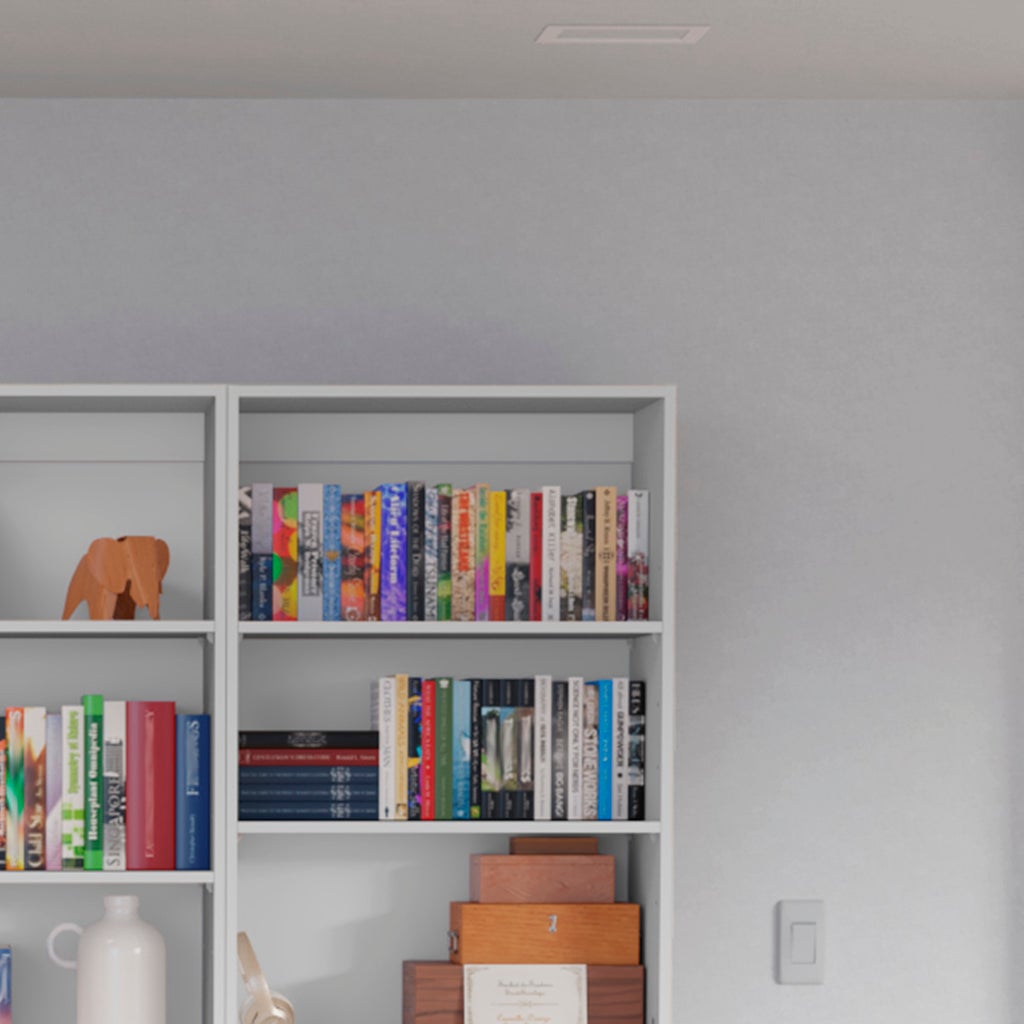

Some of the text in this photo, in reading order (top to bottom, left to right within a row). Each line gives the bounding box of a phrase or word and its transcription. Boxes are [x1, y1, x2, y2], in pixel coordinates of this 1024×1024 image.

[389, 530, 401, 585] Lifeform
[27, 804, 44, 868] Child Star
[88, 781, 101, 841] Houseplant
